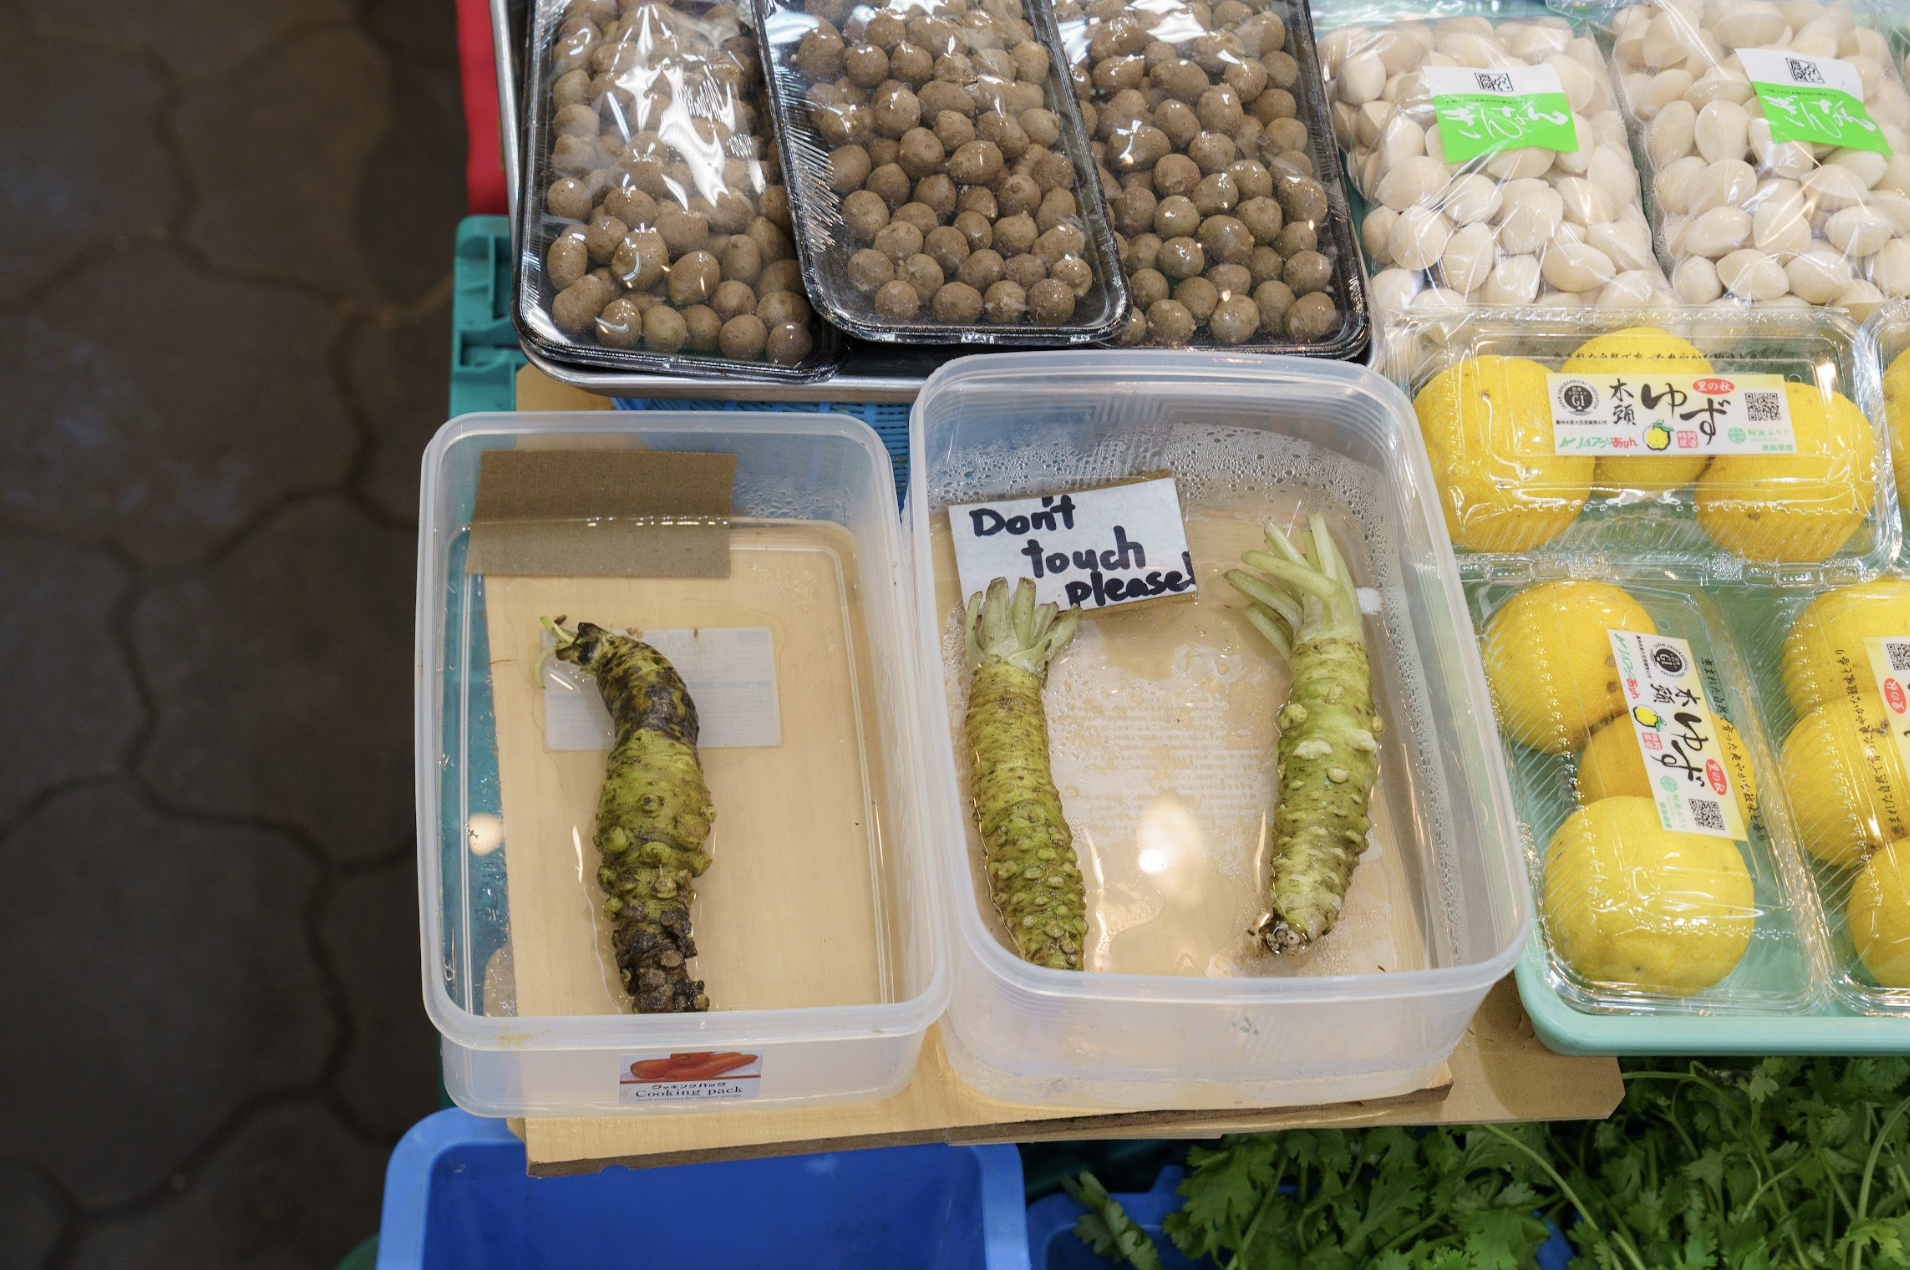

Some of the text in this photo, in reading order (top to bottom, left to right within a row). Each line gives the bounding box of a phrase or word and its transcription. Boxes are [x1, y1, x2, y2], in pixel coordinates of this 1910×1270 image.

[1571, 395, 1585, 406] GI
[1697, 380, 1732, 392] 里の秋
[1641, 382, 1731, 445] ゆず
[969, 494, 1076, 537] Don't
[1021, 525, 1146, 578] touch
[1885, 680, 1903, 711] 里の秋
[1650, 712, 1709, 787] ゆず
[1708, 762, 1725, 792] 里の秋
[635, 1086, 744, 1098] Cooking pack
